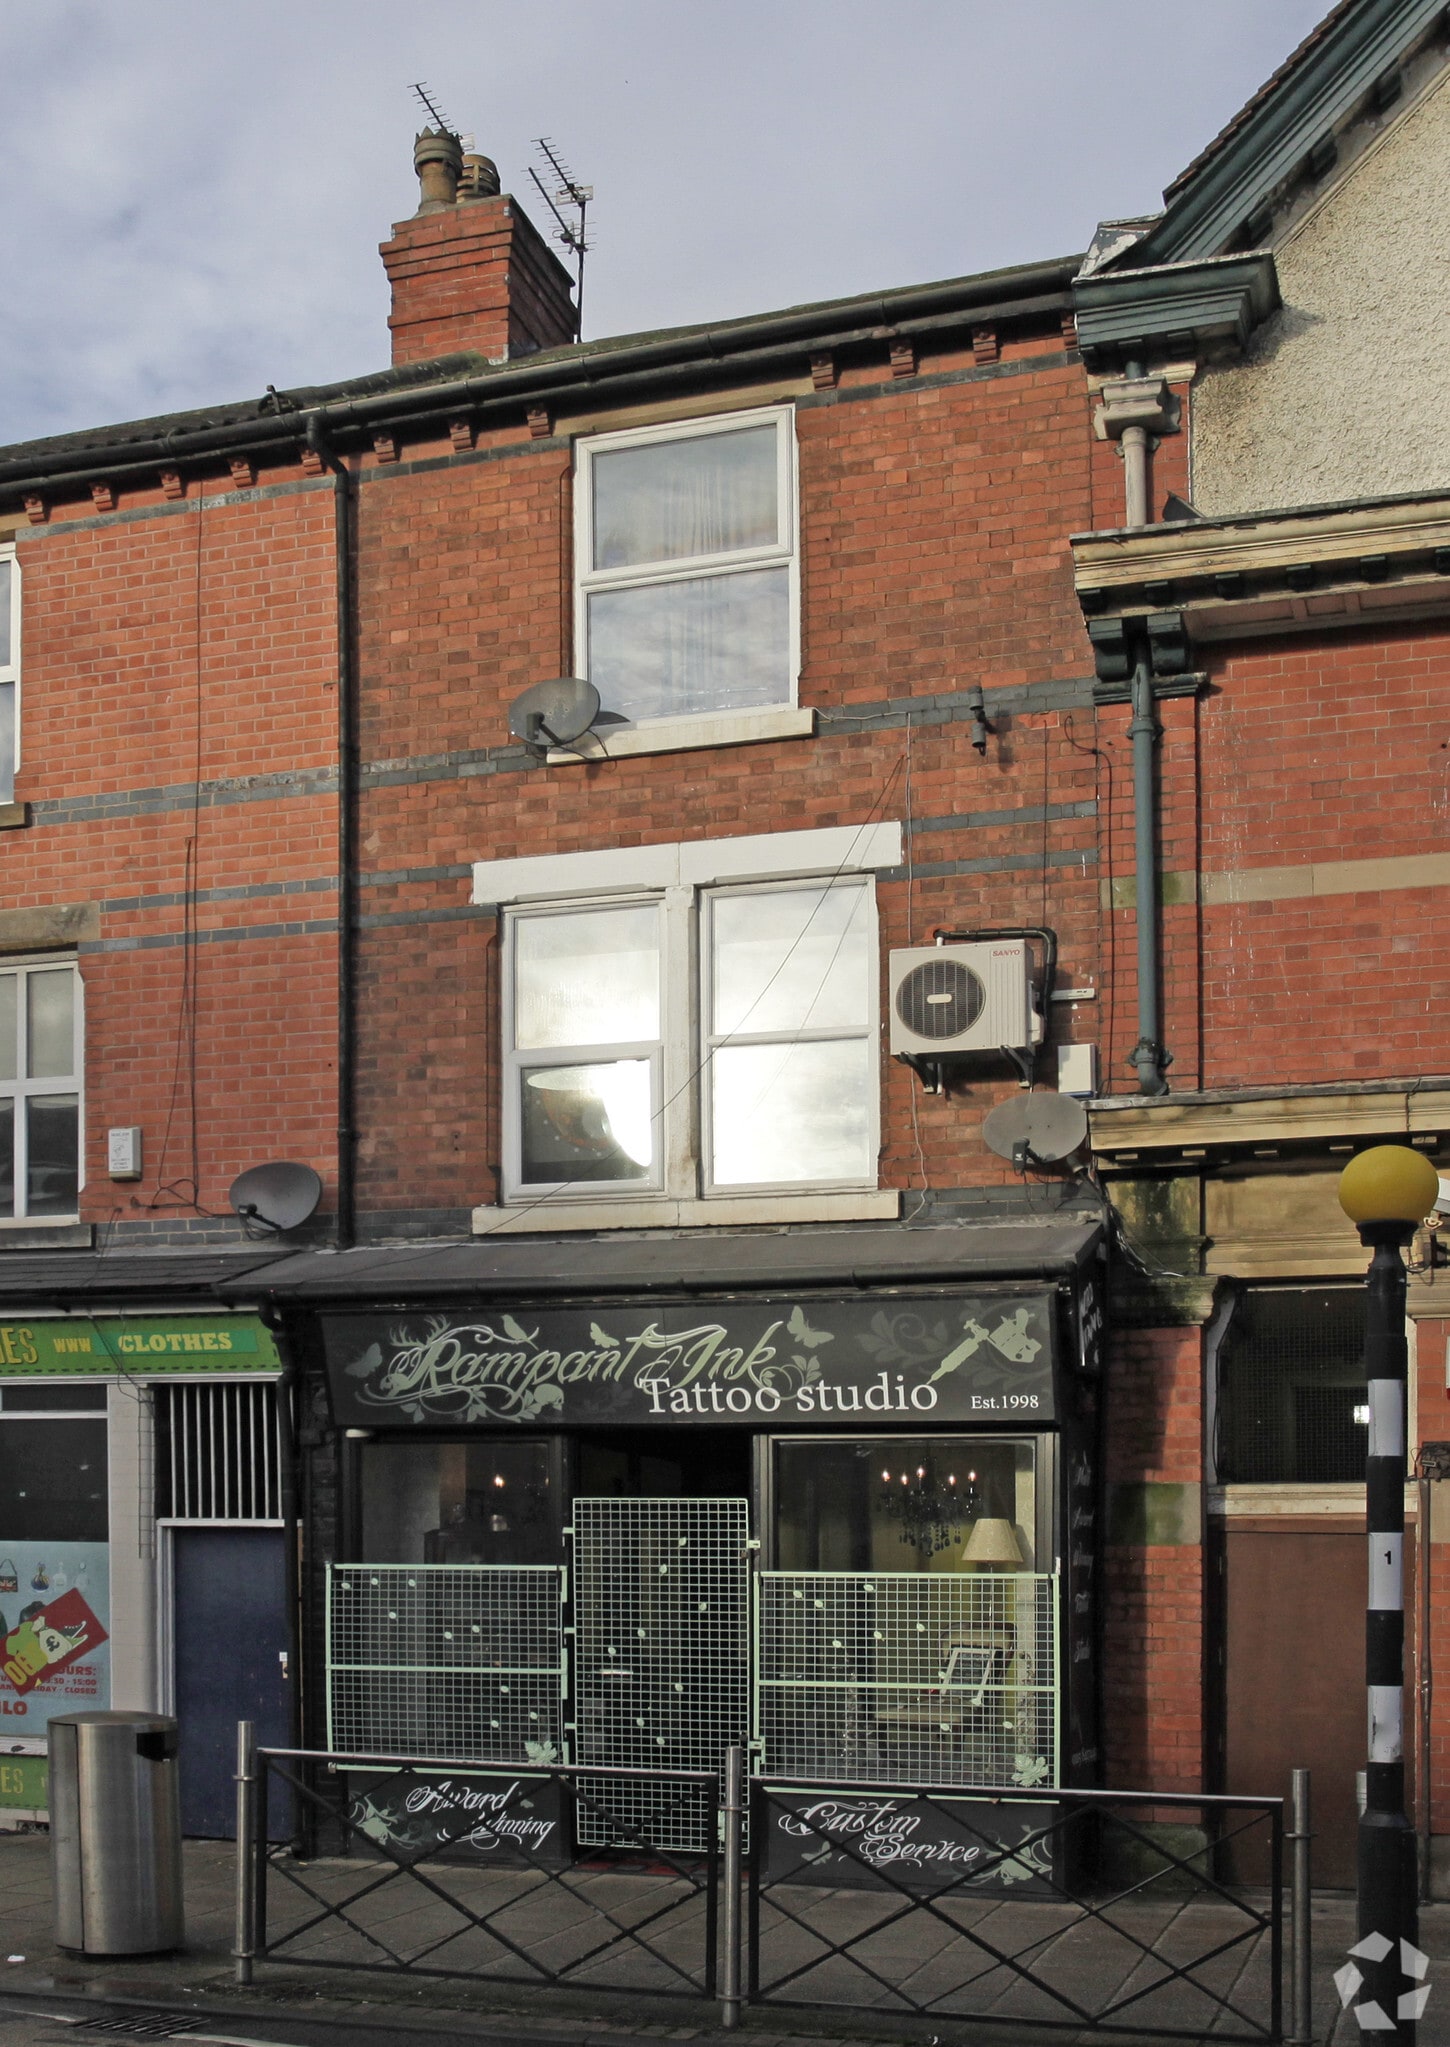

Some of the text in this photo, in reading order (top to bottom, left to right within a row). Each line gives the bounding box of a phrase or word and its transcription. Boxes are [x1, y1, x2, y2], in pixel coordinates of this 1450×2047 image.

[992, 949, 1020, 957] SANYO
[117, 1332, 233, 1352] CLOTHES
[372, 1331, 660, 1412] Rampant
[639, 1371, 939, 1414] Tattoo studio
[971, 1395, 1039, 1410] Est.1998
[1384, 1550, 1392, 1565] 1
[65, 1687, 96, 1695] CLOSED
[778, 1800, 921, 1836] Custom
[858, 1832, 980, 1868] Service
